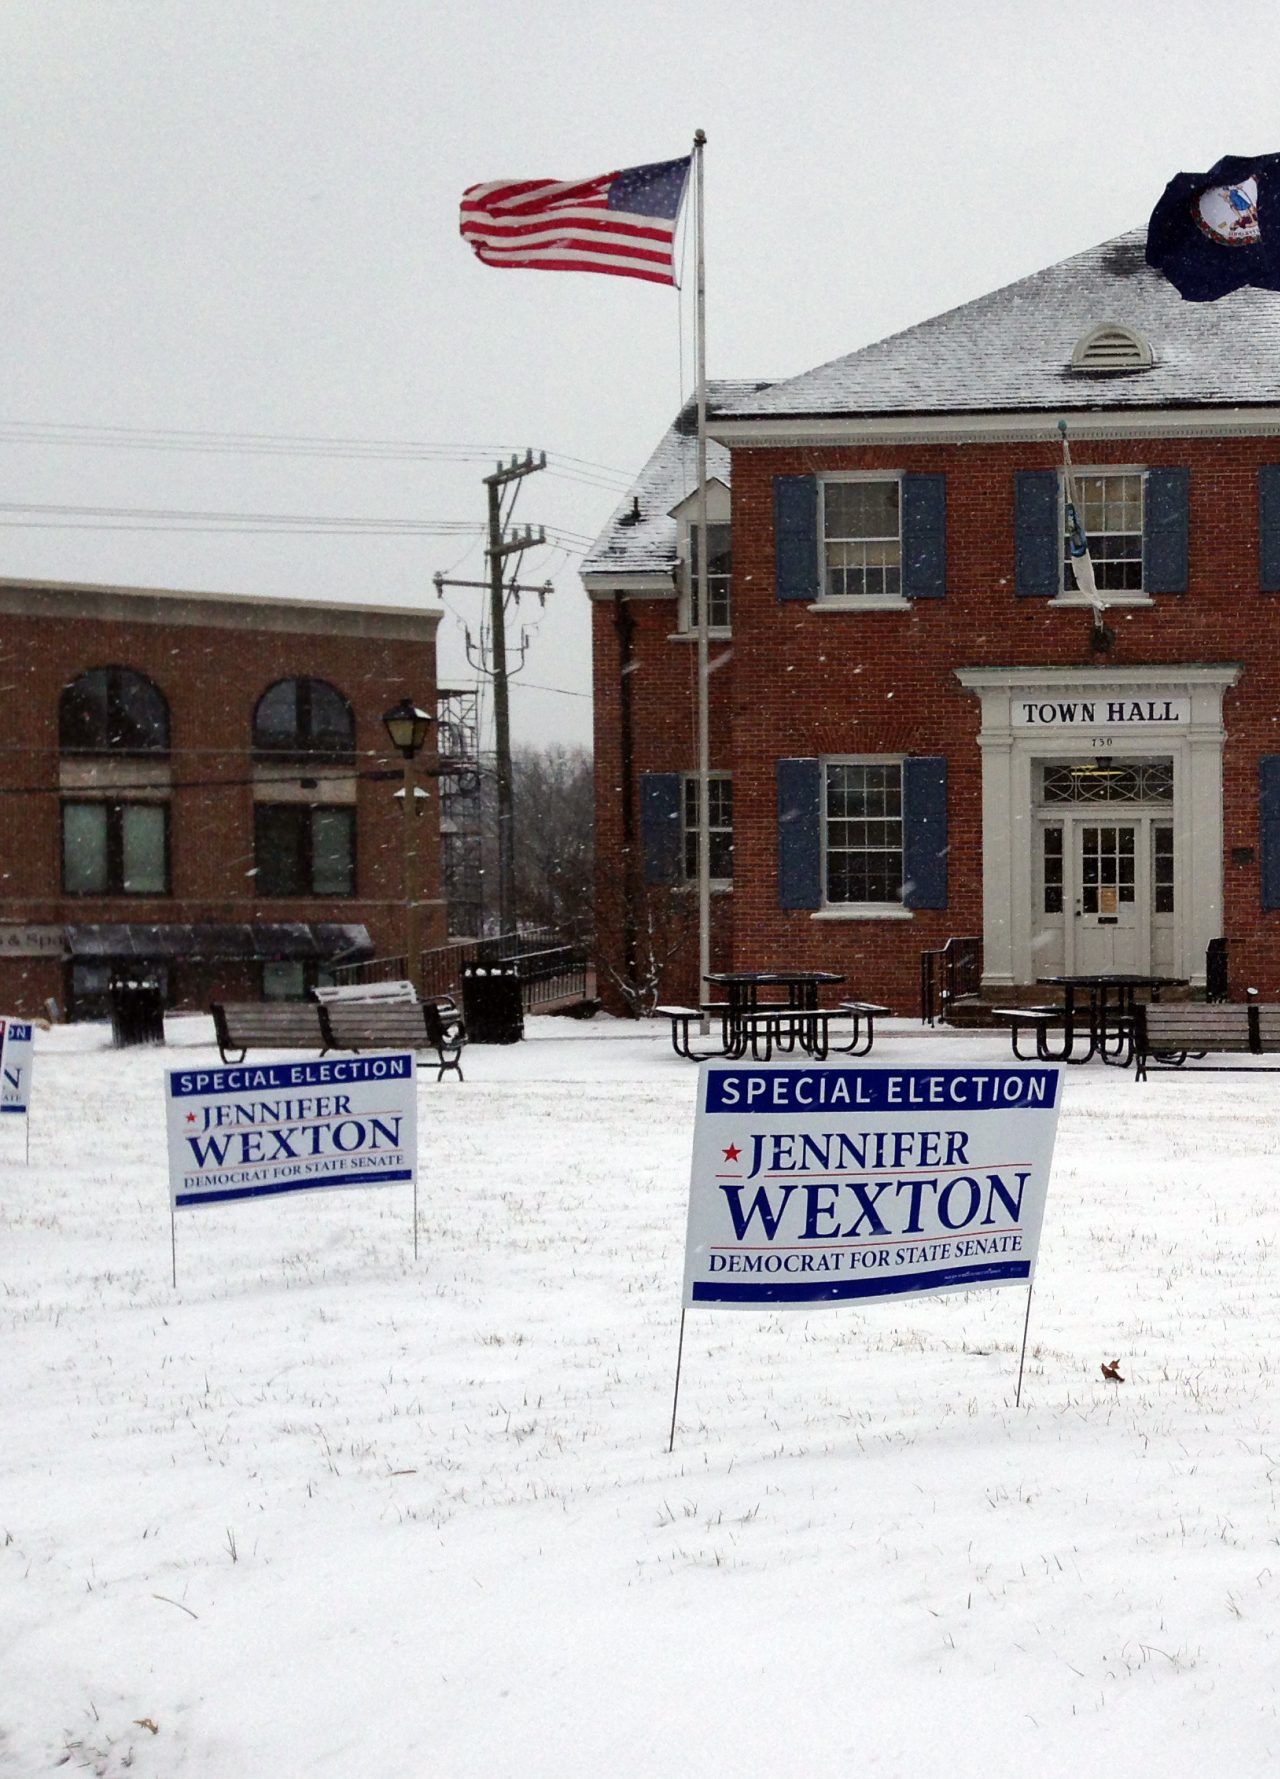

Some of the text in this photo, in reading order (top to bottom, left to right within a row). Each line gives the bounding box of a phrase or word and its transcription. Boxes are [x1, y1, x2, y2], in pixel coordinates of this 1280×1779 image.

[1023, 702, 1179, 723] TOWN HALL
[180, 1059, 404, 1092] SPECIAL ELECTION
[721, 1076, 1046, 1105] SPECIAL ELECTION
[202, 1095, 352, 1133] JENNIFER
[186, 1117, 403, 1168] WEXTON
[747, 1131, 969, 1179] JENNIFER
[184, 1154, 404, 1188] DEMOCRAT FOR STATE SENATE
[719, 1172, 1032, 1241] WEXTON
[708, 1235, 1022, 1273] DEMOCRAT FOR STATE SENATE
